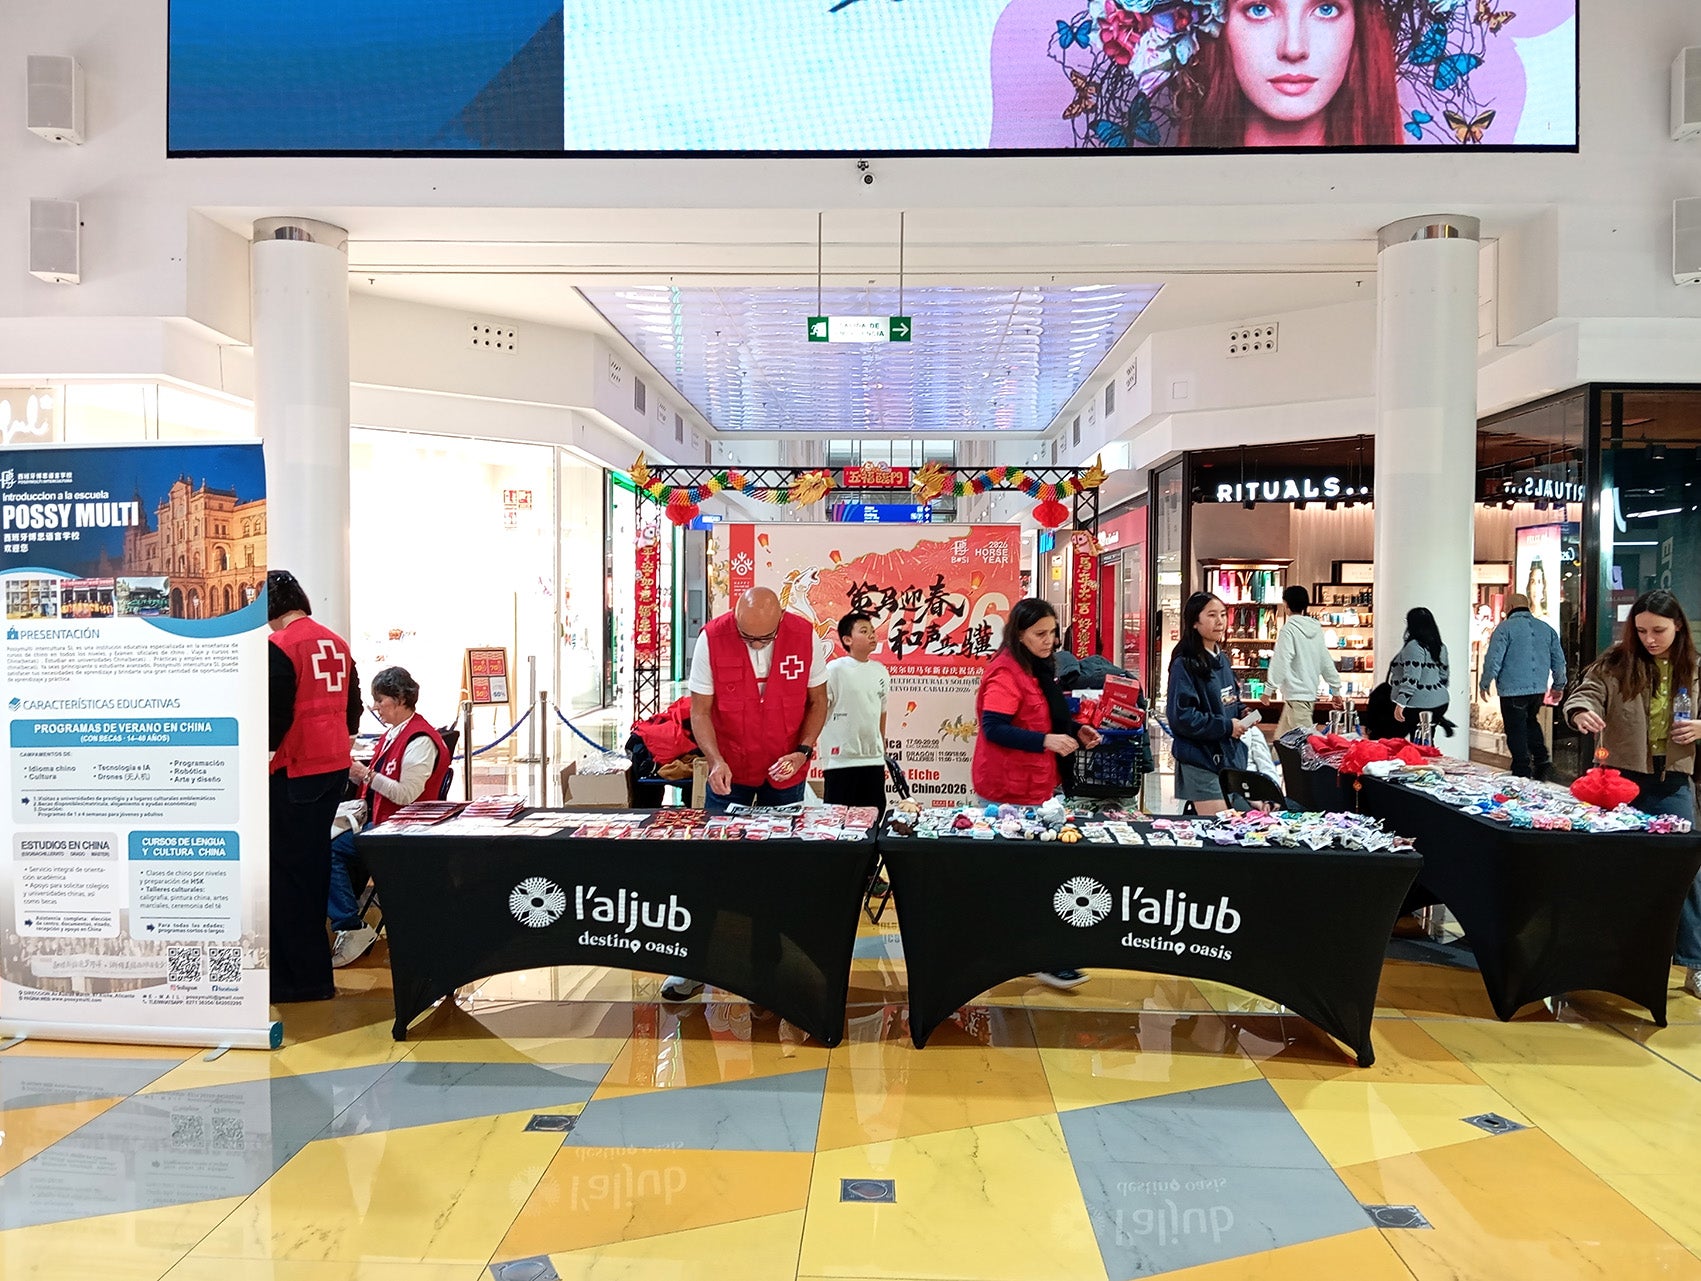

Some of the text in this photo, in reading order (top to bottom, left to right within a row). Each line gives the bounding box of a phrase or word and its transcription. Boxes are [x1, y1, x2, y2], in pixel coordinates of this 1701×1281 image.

[2, 490, 109, 502] Introduccion a la escuela
[3, 502, 138, 529] POSSY MULTI
[20, 627, 100, 640] PRESENTACIÓN
[23, 696, 181, 710] CARACTERÍSTICAS EDUCATIVAS
[34, 722, 212, 733] PROGRAMAS DE VERANO EN CHINA
[908, 769, 940, 780] Elche
[912, 784, 966, 794] Chino2026
[21, 841, 110, 850] ESTUDIOS EN CHINA
[142, 838, 226, 846] CURSOS DE LENGUA
[142, 848, 226, 856] Y CULTURA CHINA
[575, 885, 692, 934] l'aljub
[1122, 885, 1241, 935] l'aljub
[578, 930, 688, 958] destino oasis
[1121, 932, 1232, 961] destino oasis
